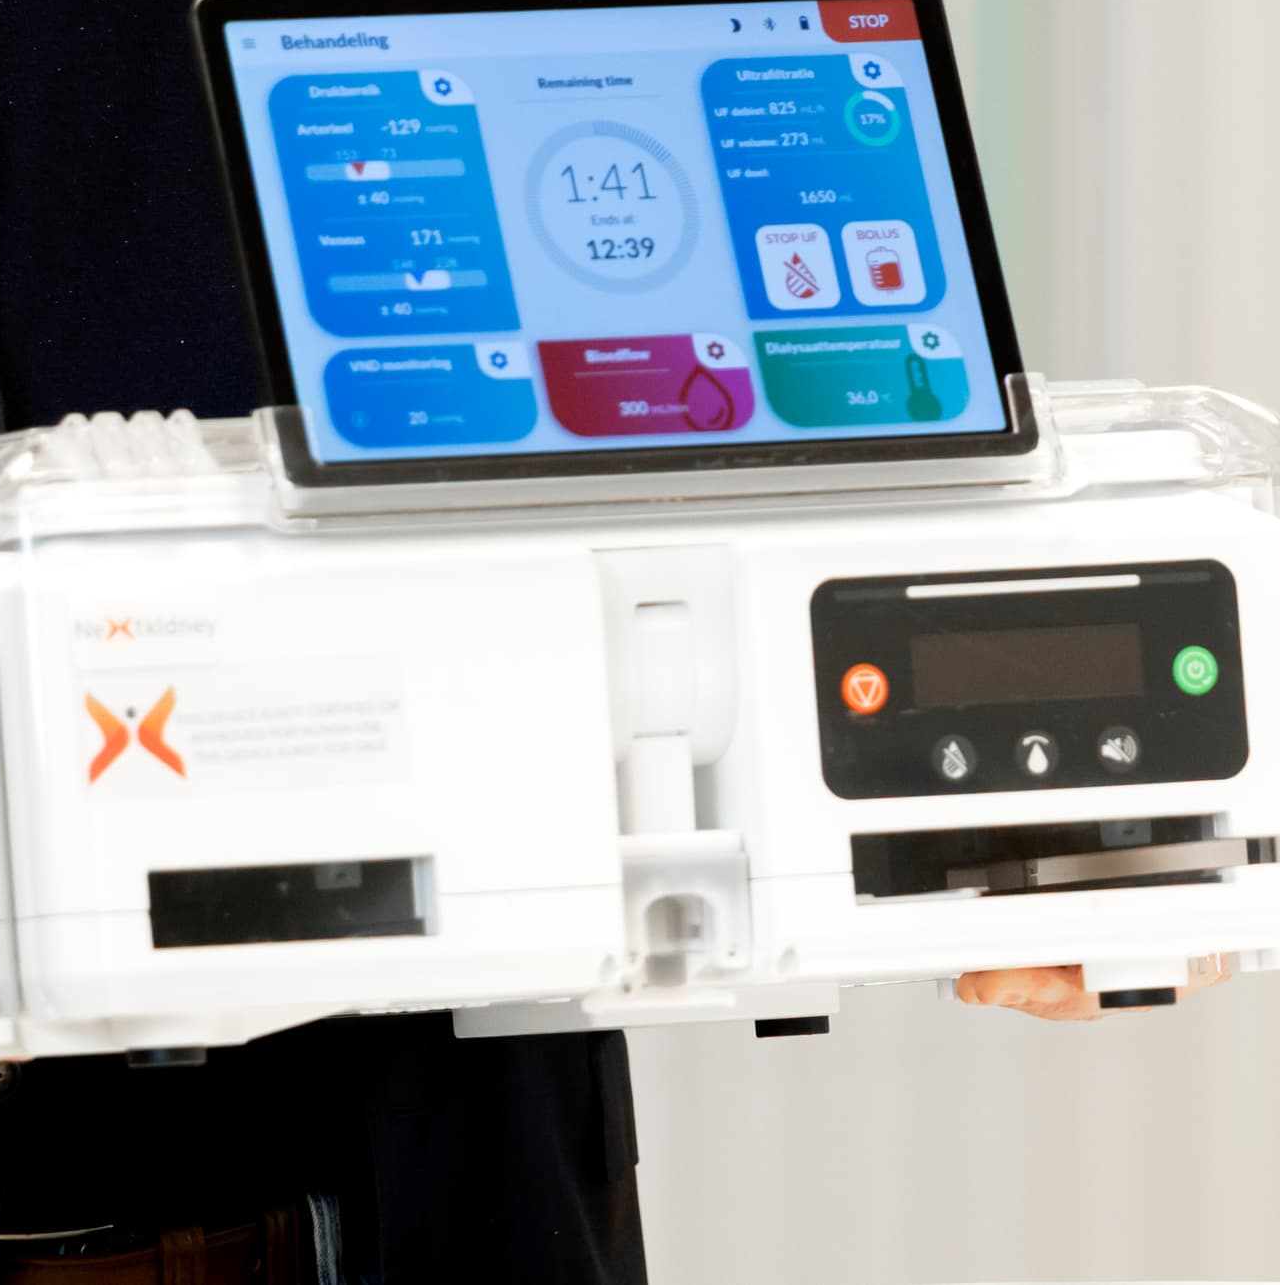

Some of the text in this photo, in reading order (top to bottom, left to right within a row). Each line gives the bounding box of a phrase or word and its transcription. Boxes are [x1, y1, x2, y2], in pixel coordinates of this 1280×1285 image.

[848, 14, 890, 29] STOP
[280, 31, 390, 51] Behandeling
[537, 75, 634, 90] Remaining time
[736, 68, 815, 82] Ultrafiltratie
[768, 100, 798, 116] 825
[381, 118, 422, 136] -129
[859, 112, 887, 126] 17%
[780, 131, 810, 147] 273
[560, 161, 657, 203] 1:41
[799, 189, 837, 205] 1650
[590, 213, 620, 227] Ends
[410, 228, 444, 247] 171
[765, 231, 818, 245] STOP UF
[855, 228, 901, 241] BOLUS
[586, 236, 656, 260] 12:39
[845, 390, 880, 407] 36.0
[618, 399, 650, 417] 300
